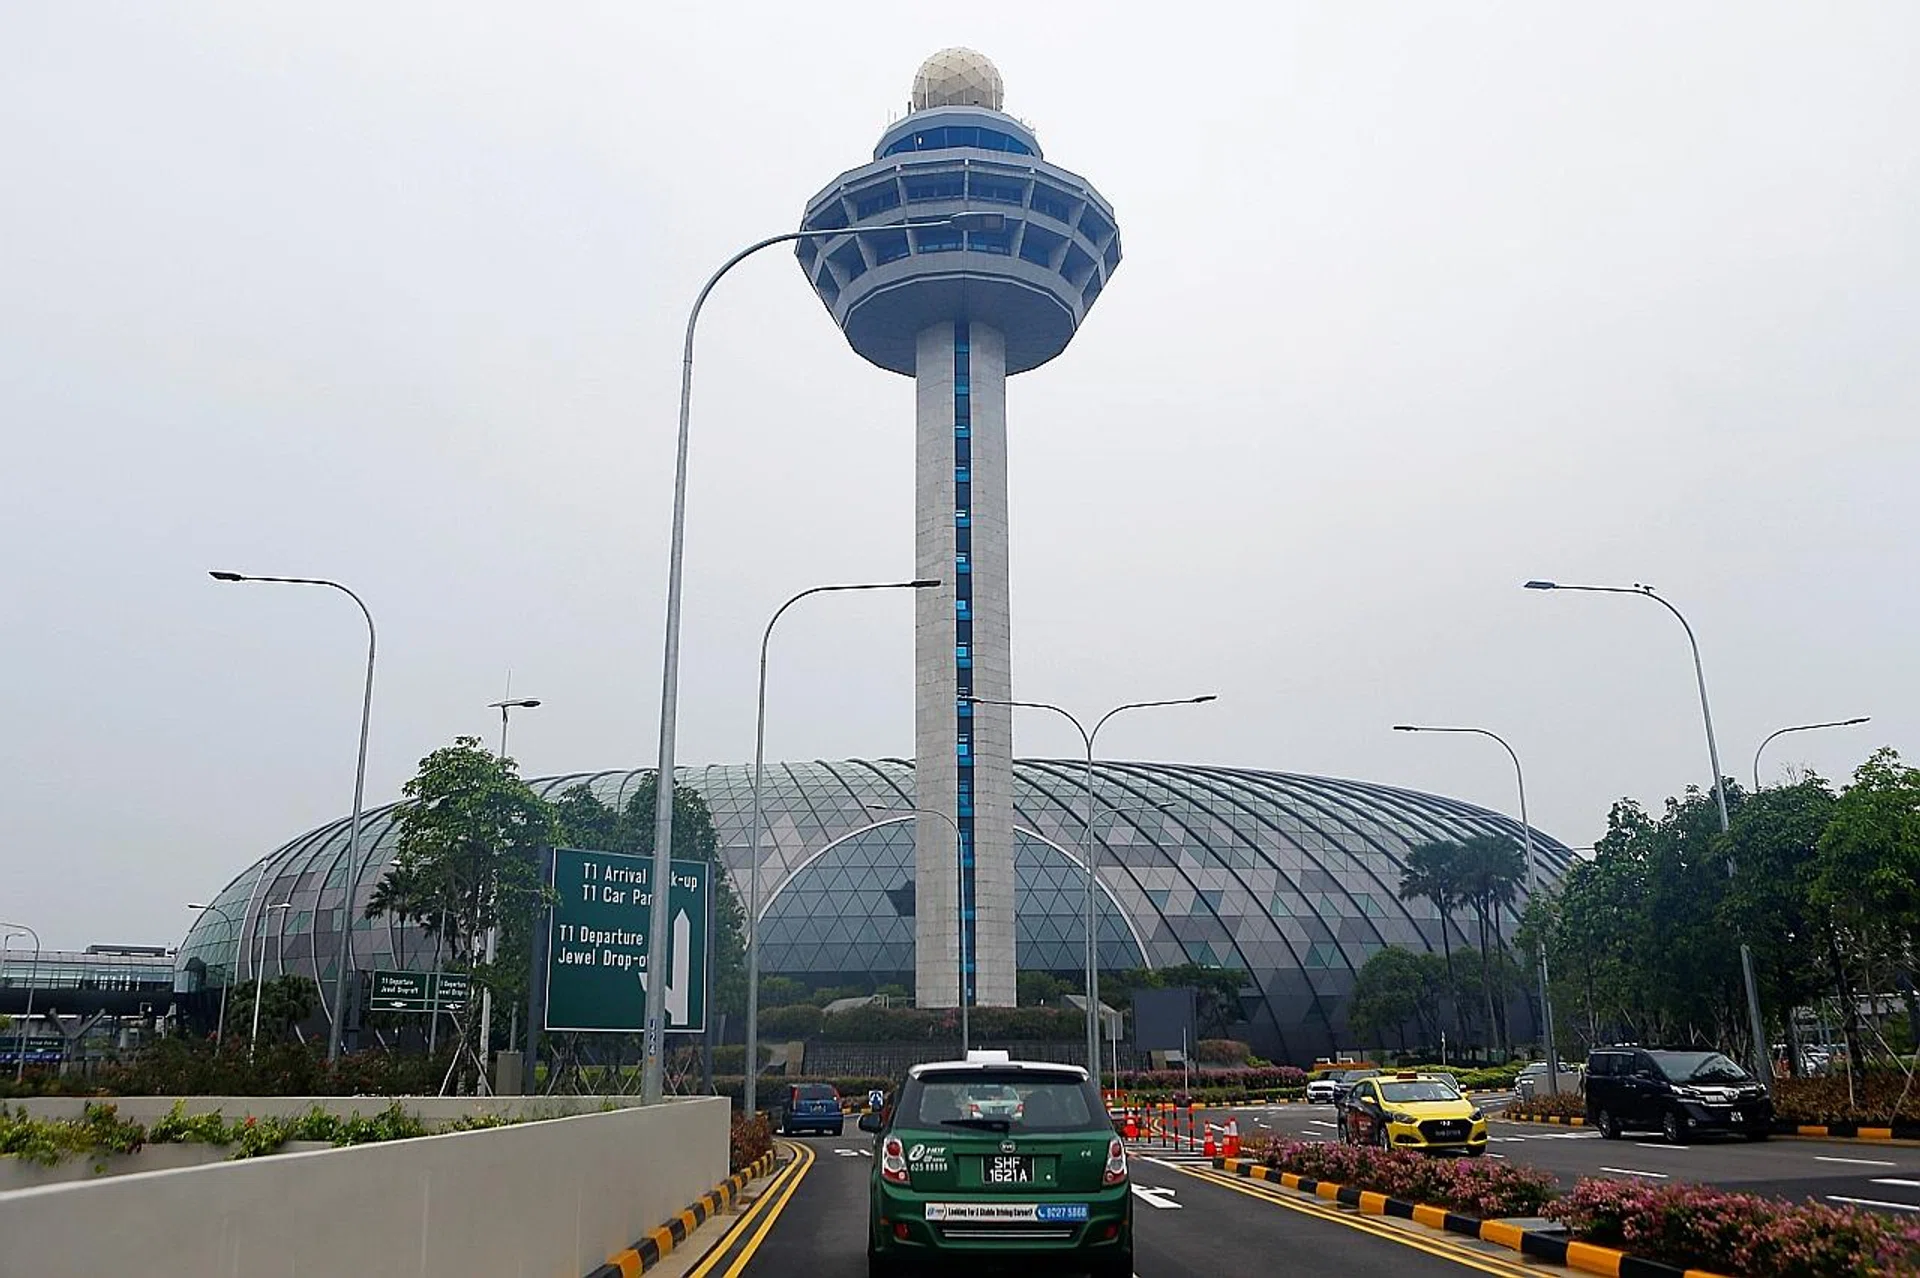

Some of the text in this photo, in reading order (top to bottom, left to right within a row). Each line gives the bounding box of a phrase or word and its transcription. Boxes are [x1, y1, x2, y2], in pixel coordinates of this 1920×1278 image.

[583, 862, 698, 893] T1 Arrival k-up
[582, 884, 653, 906] T1 Car Par
[559, 924, 643, 947] T1 Departure
[558, 947, 649, 971] Jewel Drop-o
[994, 1156, 1021, 1170] SHF
[990, 1168, 1028, 1182] 1621A
